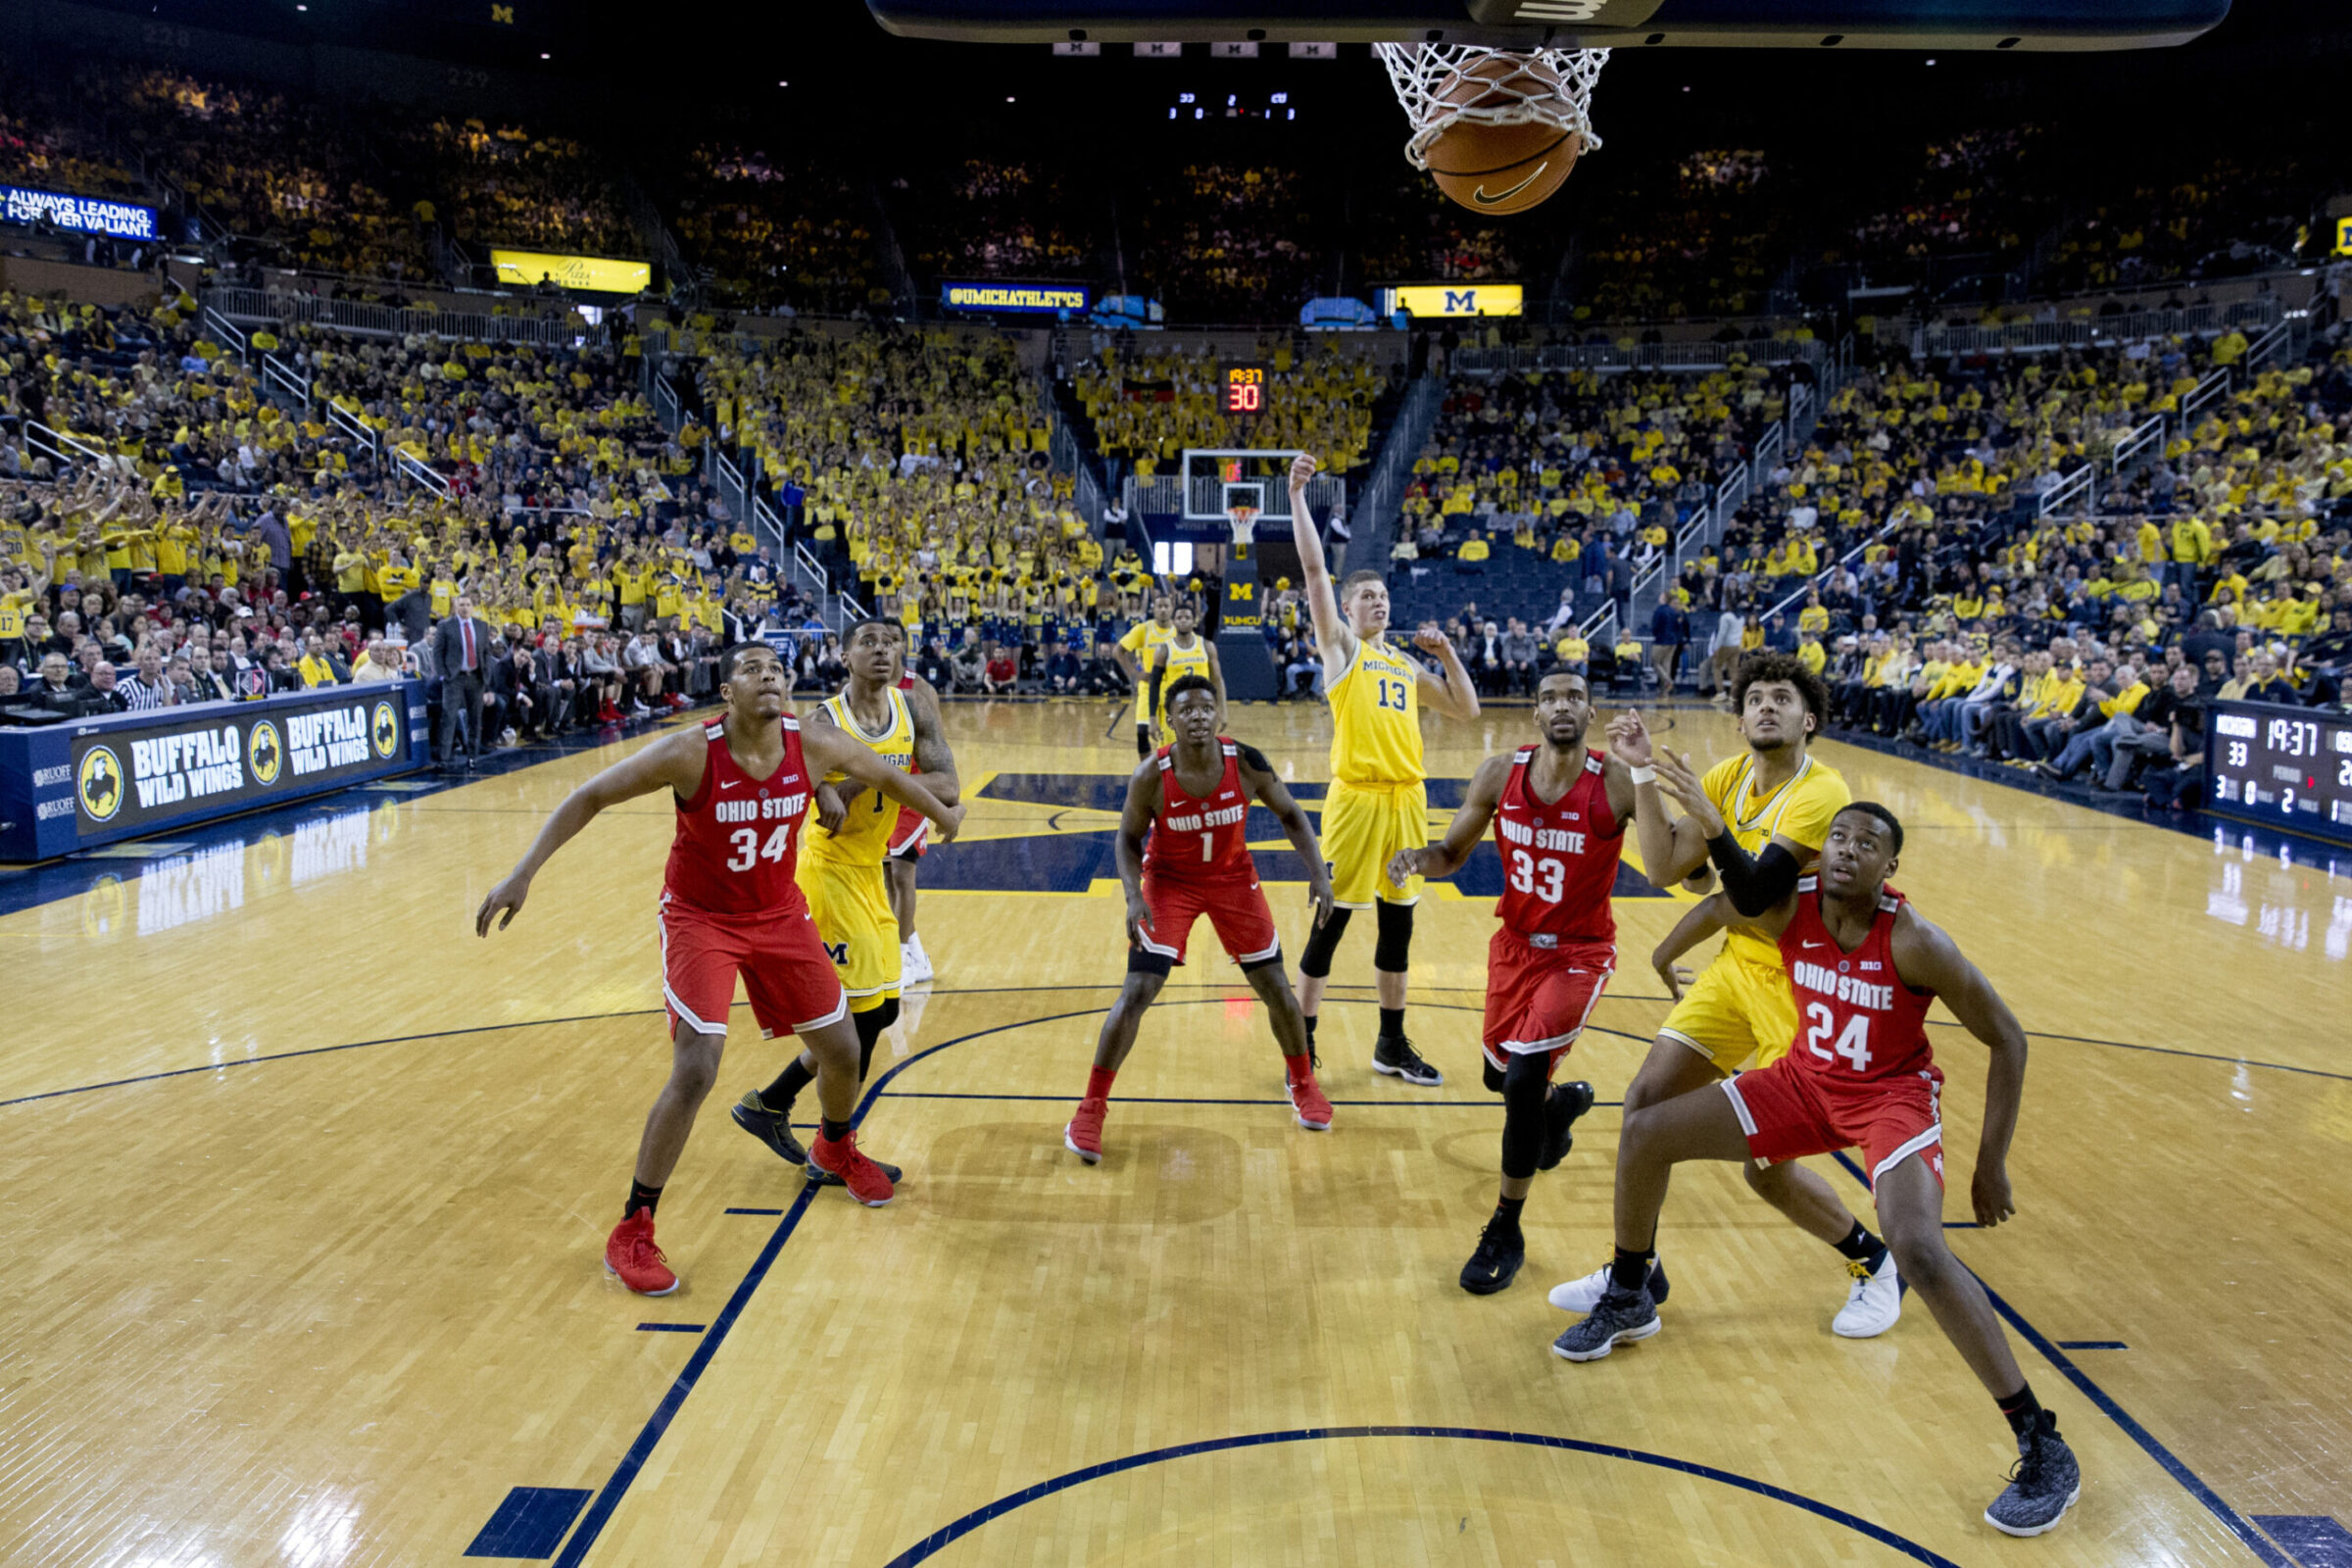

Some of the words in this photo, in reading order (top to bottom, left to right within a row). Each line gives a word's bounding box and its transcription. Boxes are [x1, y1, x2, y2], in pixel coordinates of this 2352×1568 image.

[491, 4, 514, 24] M
[8, 189, 75, 213] ALWAYS
[8, 203, 82, 227] FORVER
[84, 215, 152, 238] VALIANT.
[1446, 291, 1475, 312] M
[1229, 368, 1262, 384] 19:37
[1229, 383, 1258, 410] 30
[1229, 582, 1253, 601] M
[1378, 678, 1406, 711] 13
[285, 706, 367, 751] BUFFALO
[2268, 718, 2318, 757] 19:37
[130, 726, 240, 780] BUFFALO
[290, 746, 327, 775] WILD
[327, 737, 369, 767] WINGS
[2229, 741, 2248, 767] 33
[43, 764, 71, 779] RUOFF
[135, 772, 186, 808] WILD
[186, 761, 243, 798] WINGS
[2338, 760, 2352, 786] 2
[2216, 774, 2227, 799] 3
[2245, 780, 2256, 805] 0
[2281, 788, 2294, 813] 2
[47, 797, 74, 812] RUOFF
[715, 800, 759, 823] OHIO
[761, 792, 808, 820] STATE
[1166, 813, 1202, 832] OHIO
[1203, 804, 1244, 827] STATE
[2331, 799, 2338, 821] 1
[727, 824, 790, 872] 34
[1200, 831, 1213, 862] 1
[1500, 816, 1533, 847] OHIO
[1536, 828, 1586, 855] STATE
[1510, 848, 1566, 905] 33
[1793, 960, 1838, 996] OHIO
[1838, 975, 1893, 1011] STATE
[1806, 1001, 1873, 1072] 24
